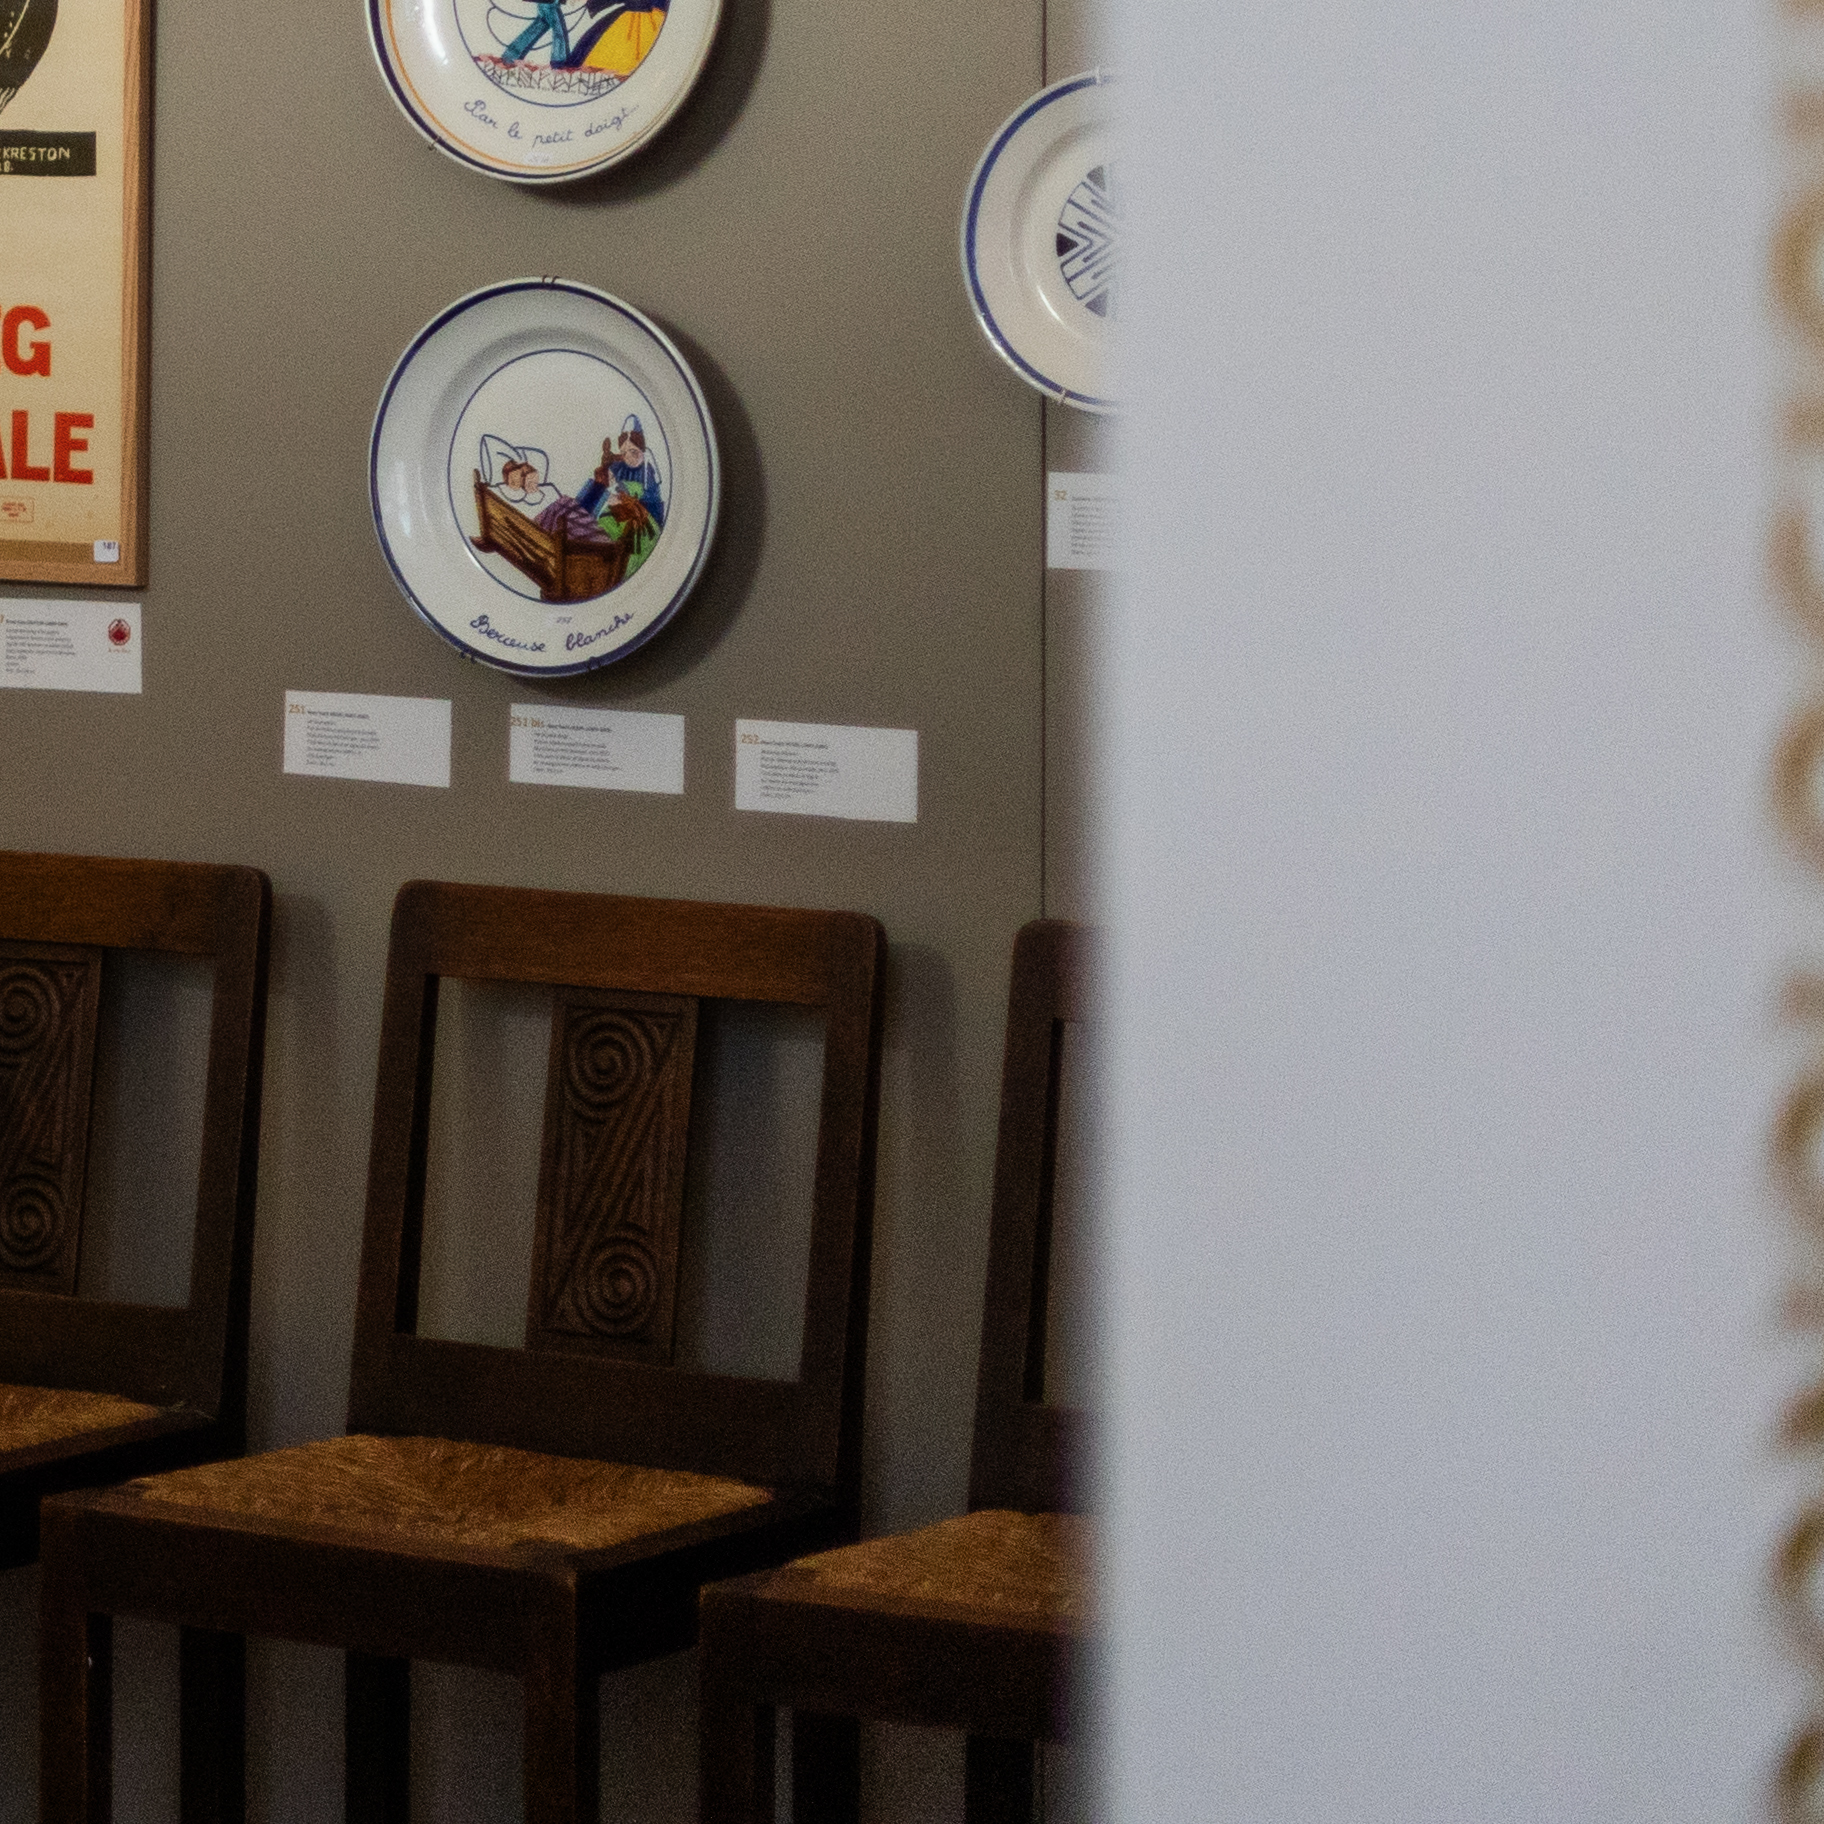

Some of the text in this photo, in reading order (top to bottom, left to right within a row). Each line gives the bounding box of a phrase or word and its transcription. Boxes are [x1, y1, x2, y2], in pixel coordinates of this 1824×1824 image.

[507, 121, 523, 140] le
[532, 129, 574, 148] petit
[469, 611, 635, 653] Berceuse blanche
